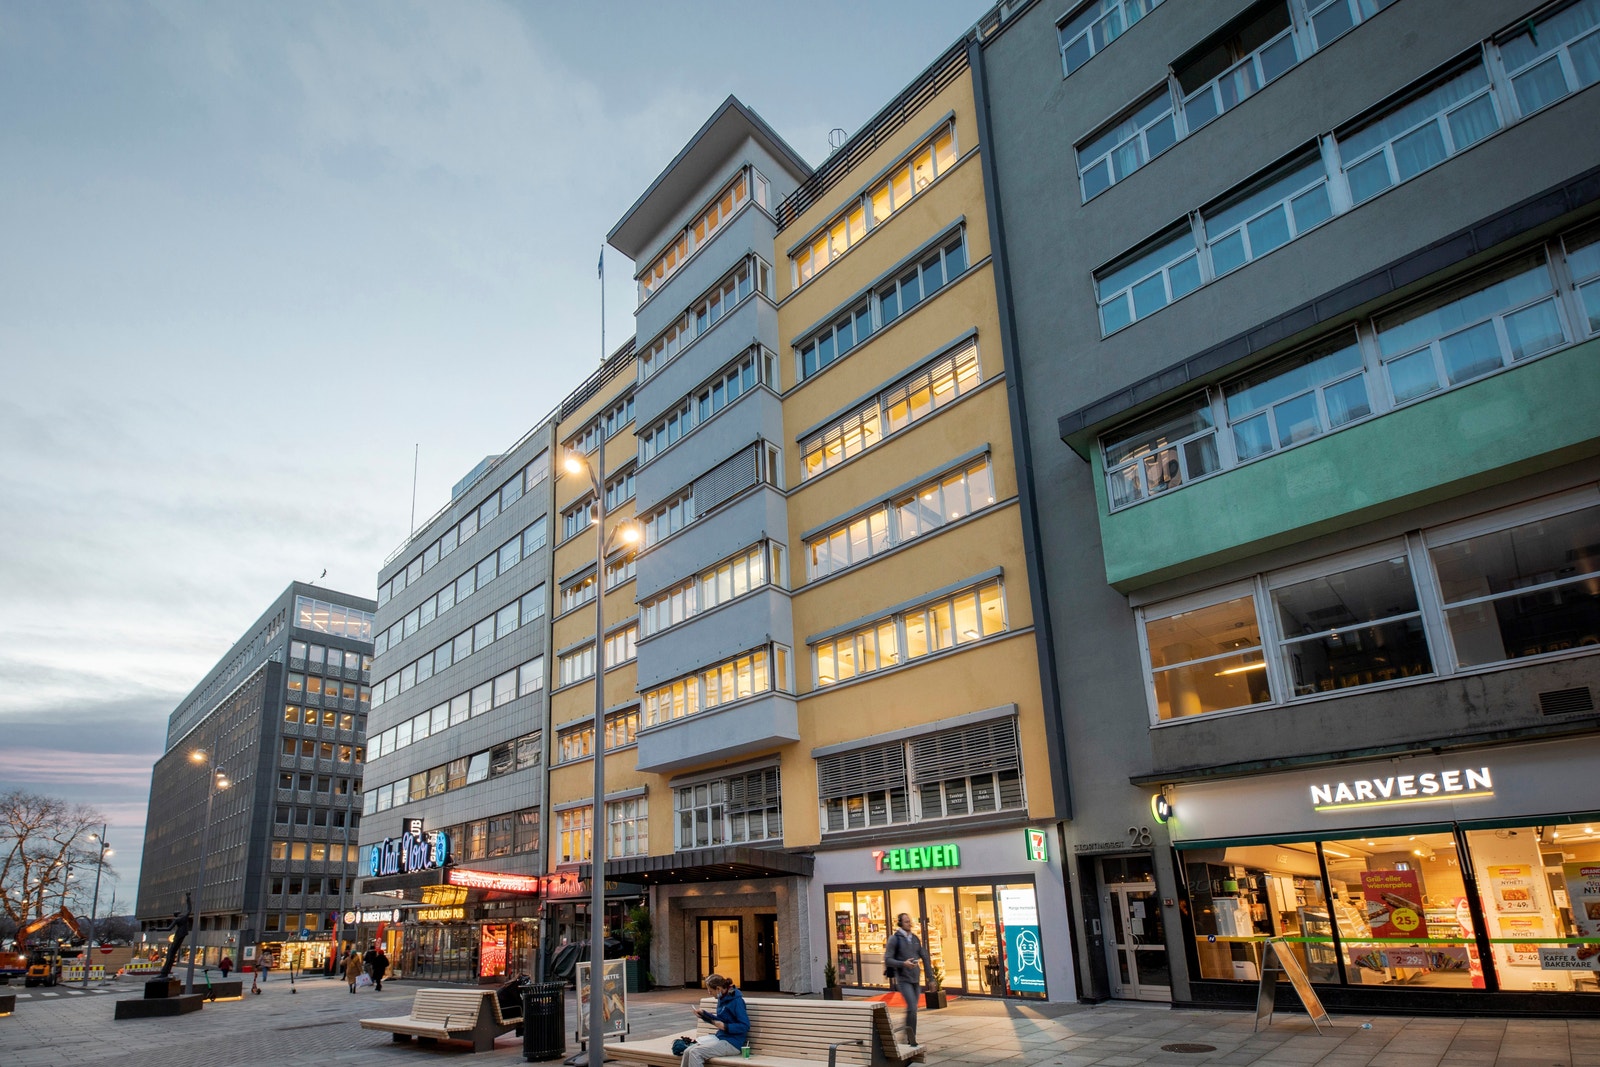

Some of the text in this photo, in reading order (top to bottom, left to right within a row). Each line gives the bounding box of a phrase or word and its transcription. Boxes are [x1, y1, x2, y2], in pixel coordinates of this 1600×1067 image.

[1310, 767, 1493, 804] NARVESEN
[1159, 802, 1168, 815] N
[1128, 826, 1152, 847] 28
[380, 837, 399, 875] Chat
[403, 832, 432, 872] Noir
[362, 912, 380, 922] BURGER
[380, 911, 392, 921] KING
[418, 908, 464, 920] THE OLD IRISH PUB
[1396, 956, 1402, 964] 2
